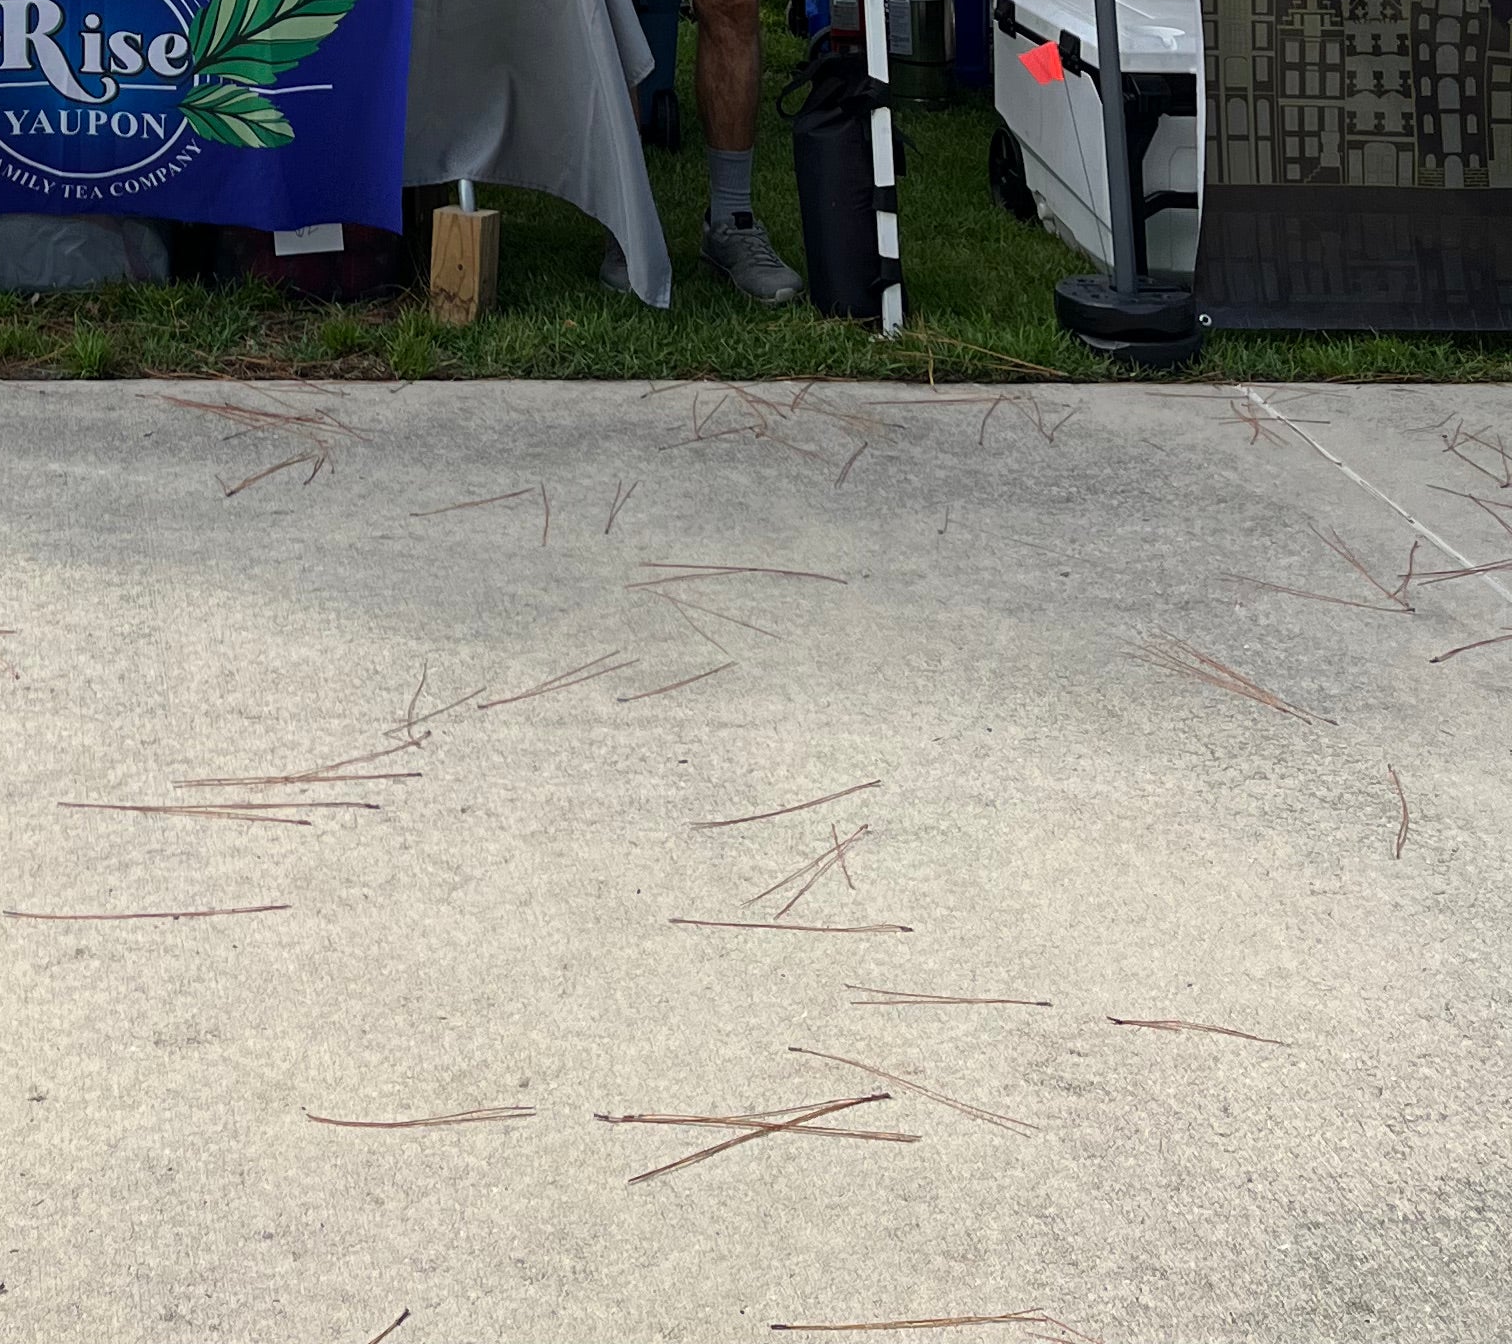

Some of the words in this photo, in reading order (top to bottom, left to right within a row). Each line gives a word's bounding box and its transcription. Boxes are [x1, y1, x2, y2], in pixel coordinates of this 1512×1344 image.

[2, 108, 168, 141] YAUPON
[61, 183, 104, 200] TEA
[109, 137, 204, 198] COMPANY
